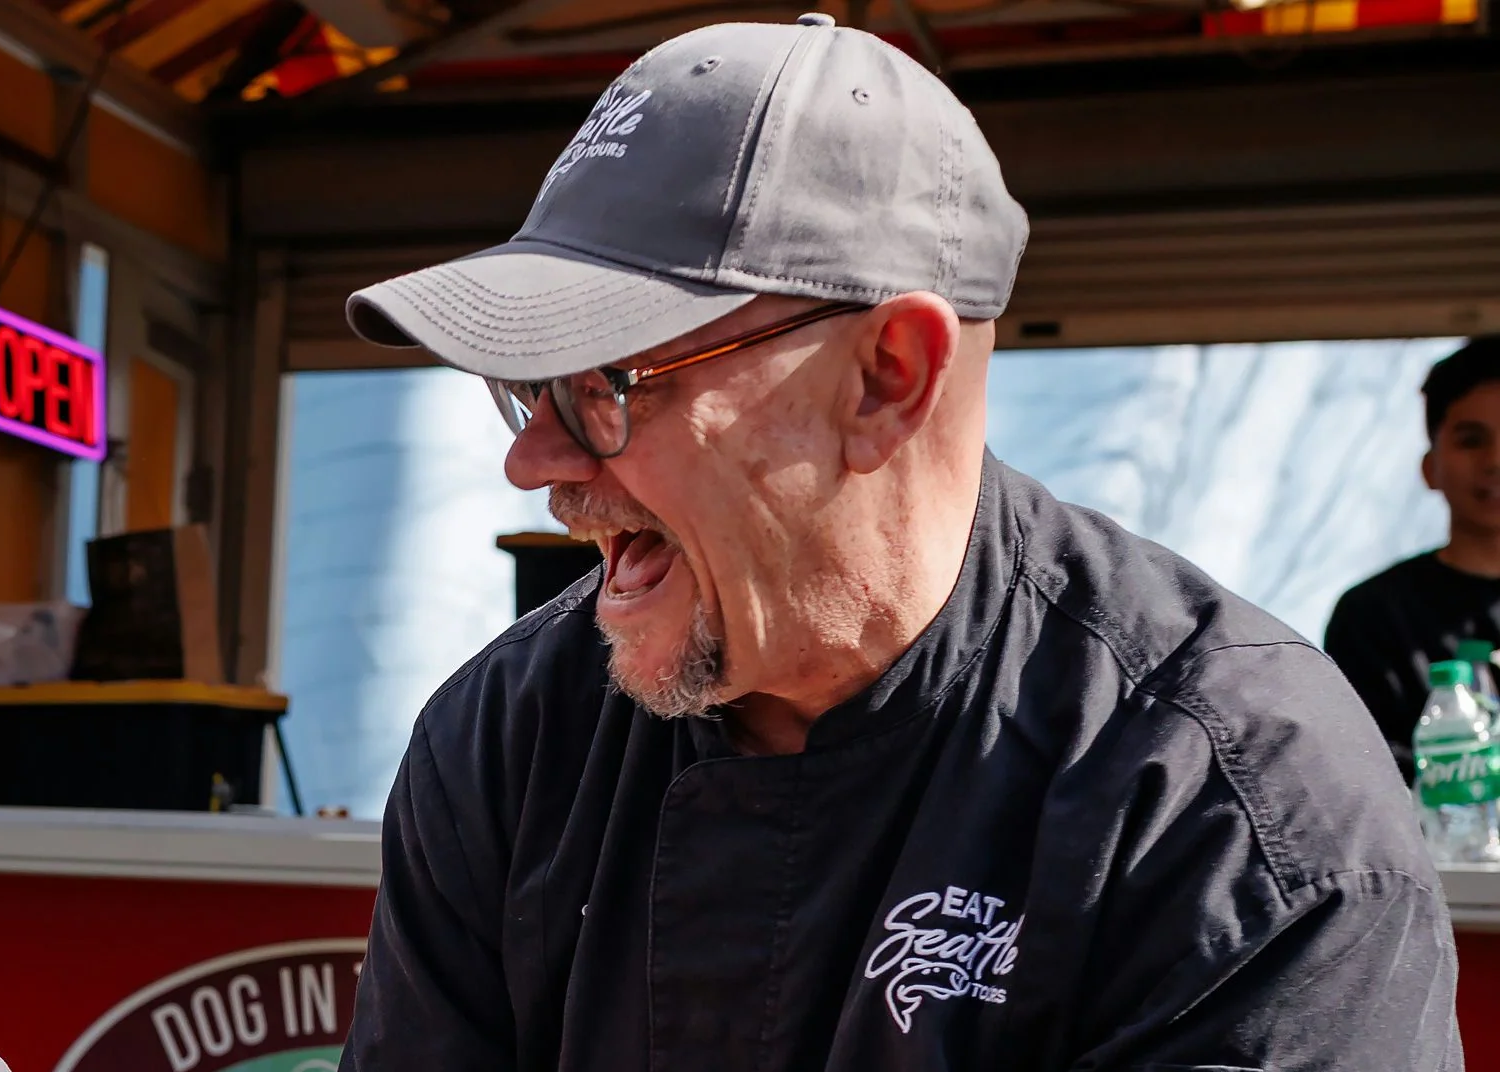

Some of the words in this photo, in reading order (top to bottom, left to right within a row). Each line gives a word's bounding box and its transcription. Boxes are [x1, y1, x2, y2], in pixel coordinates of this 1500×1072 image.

[585, 139, 629, 159] TOURS
[941, 885, 1005, 926] EAT
[864, 892, 1026, 980] Seattle
[279, 963, 337, 1038] IN
